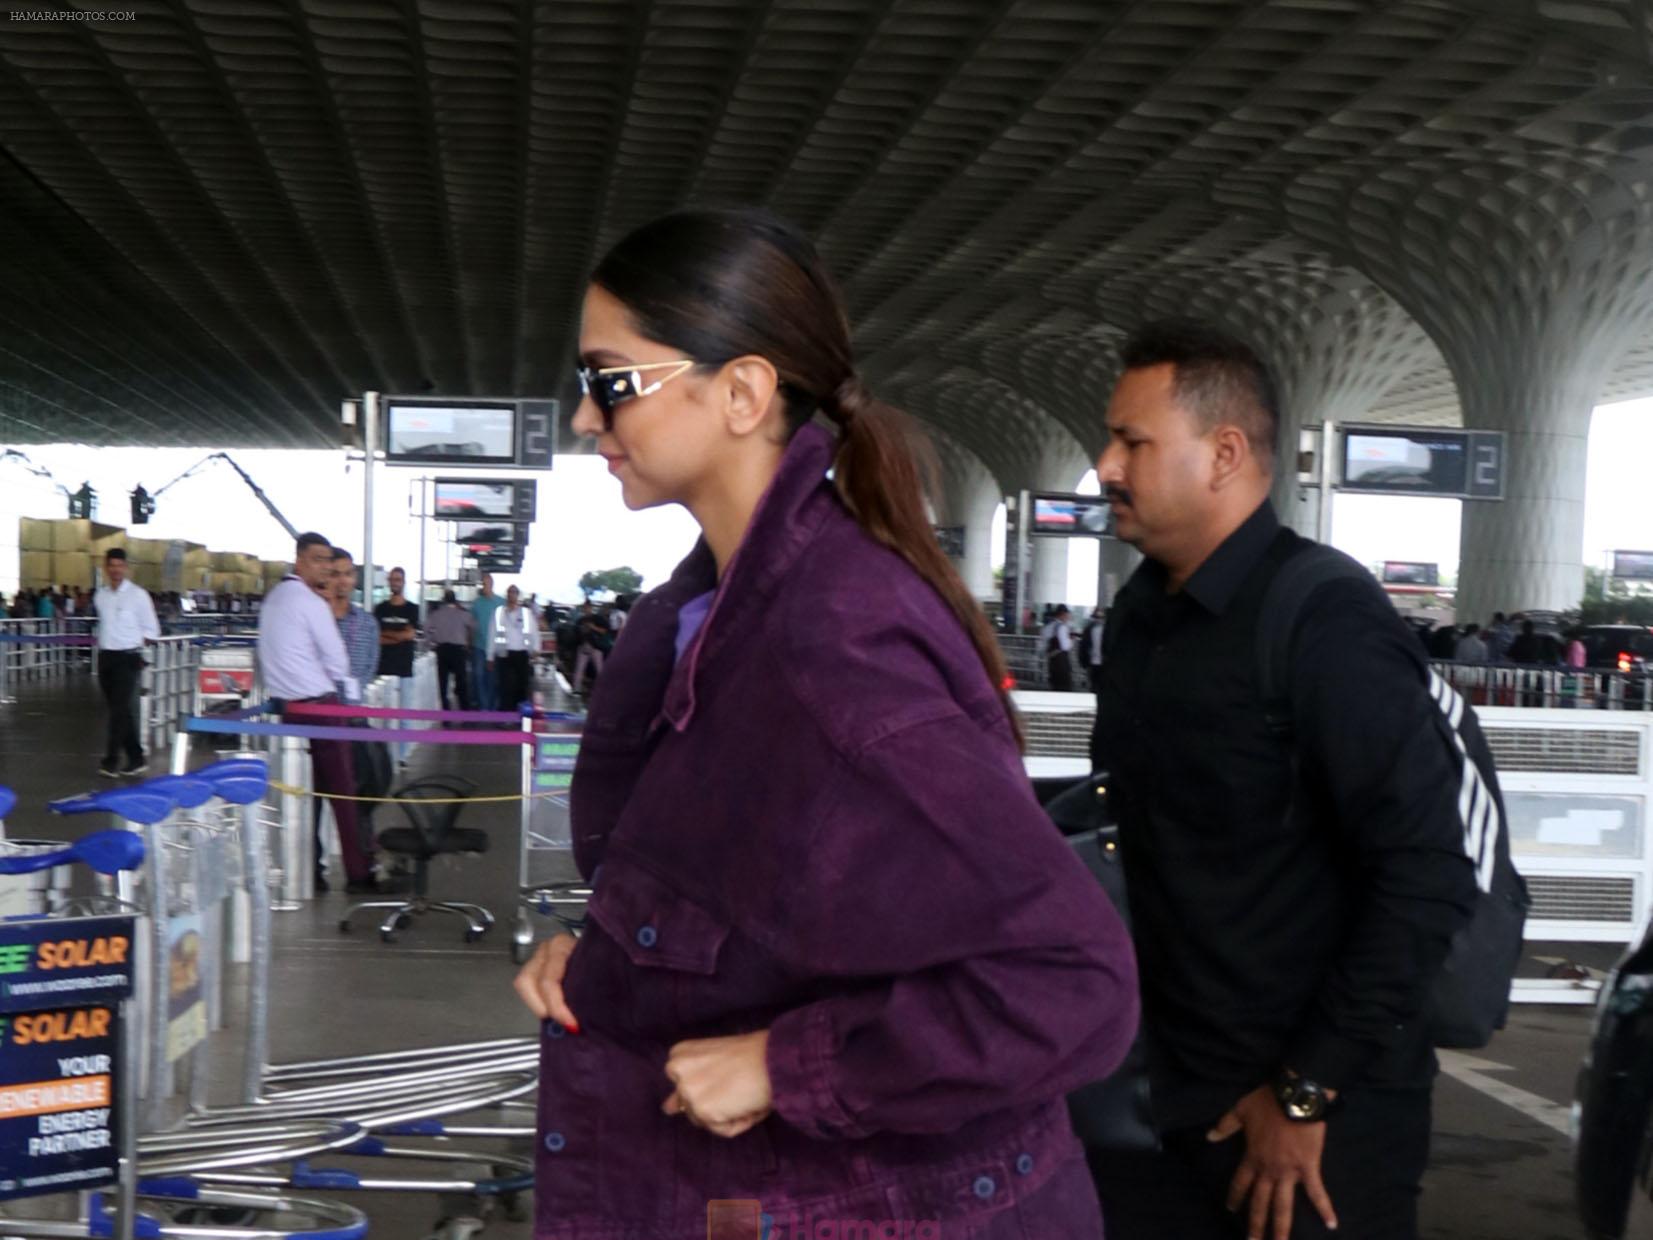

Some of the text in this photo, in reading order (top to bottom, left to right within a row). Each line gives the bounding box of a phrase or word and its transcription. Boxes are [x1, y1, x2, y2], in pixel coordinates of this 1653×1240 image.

[37, 936, 129, 970] SOLAR
[12, 1008, 111, 1045] SOLAR
[57, 1054, 111, 1077] YOUR
[0, 1081, 106, 1113] ENEWABLE
[38, 1108, 111, 1135] ENERGY
[28, 1128, 112, 1157] PARTNER
